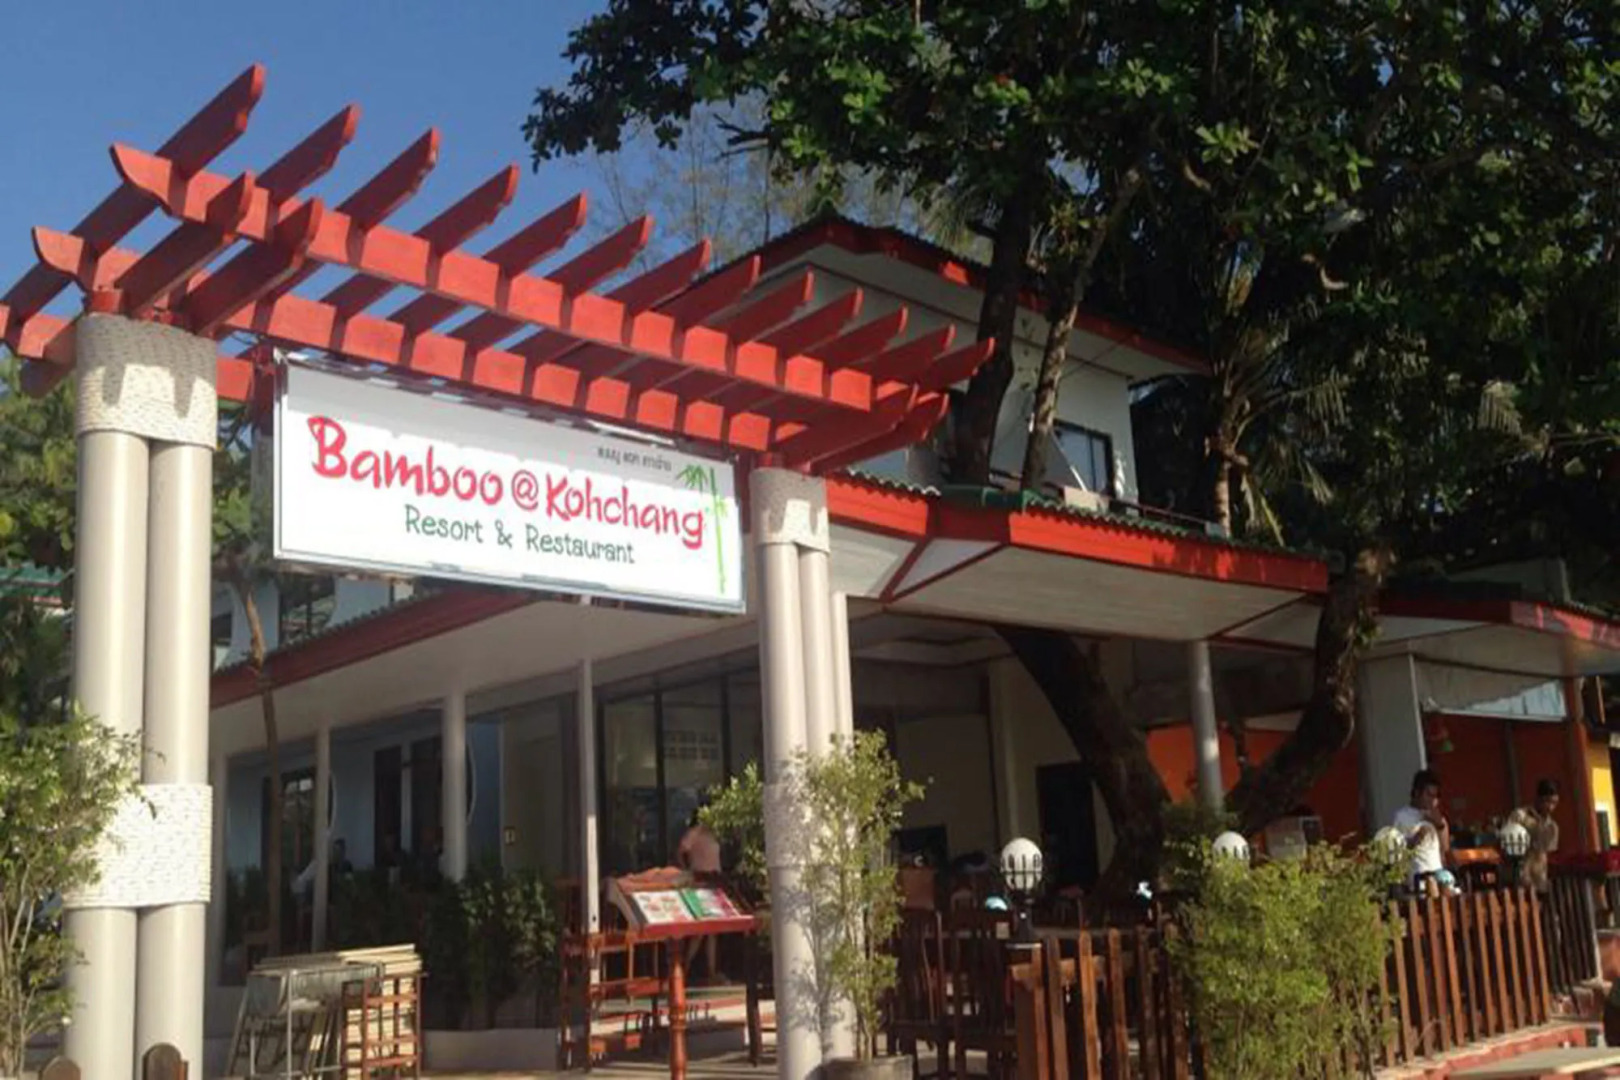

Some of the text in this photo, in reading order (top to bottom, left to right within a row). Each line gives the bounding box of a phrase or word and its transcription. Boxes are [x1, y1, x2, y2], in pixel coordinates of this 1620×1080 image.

[404, 503, 636, 565] Resort & Restaurant
